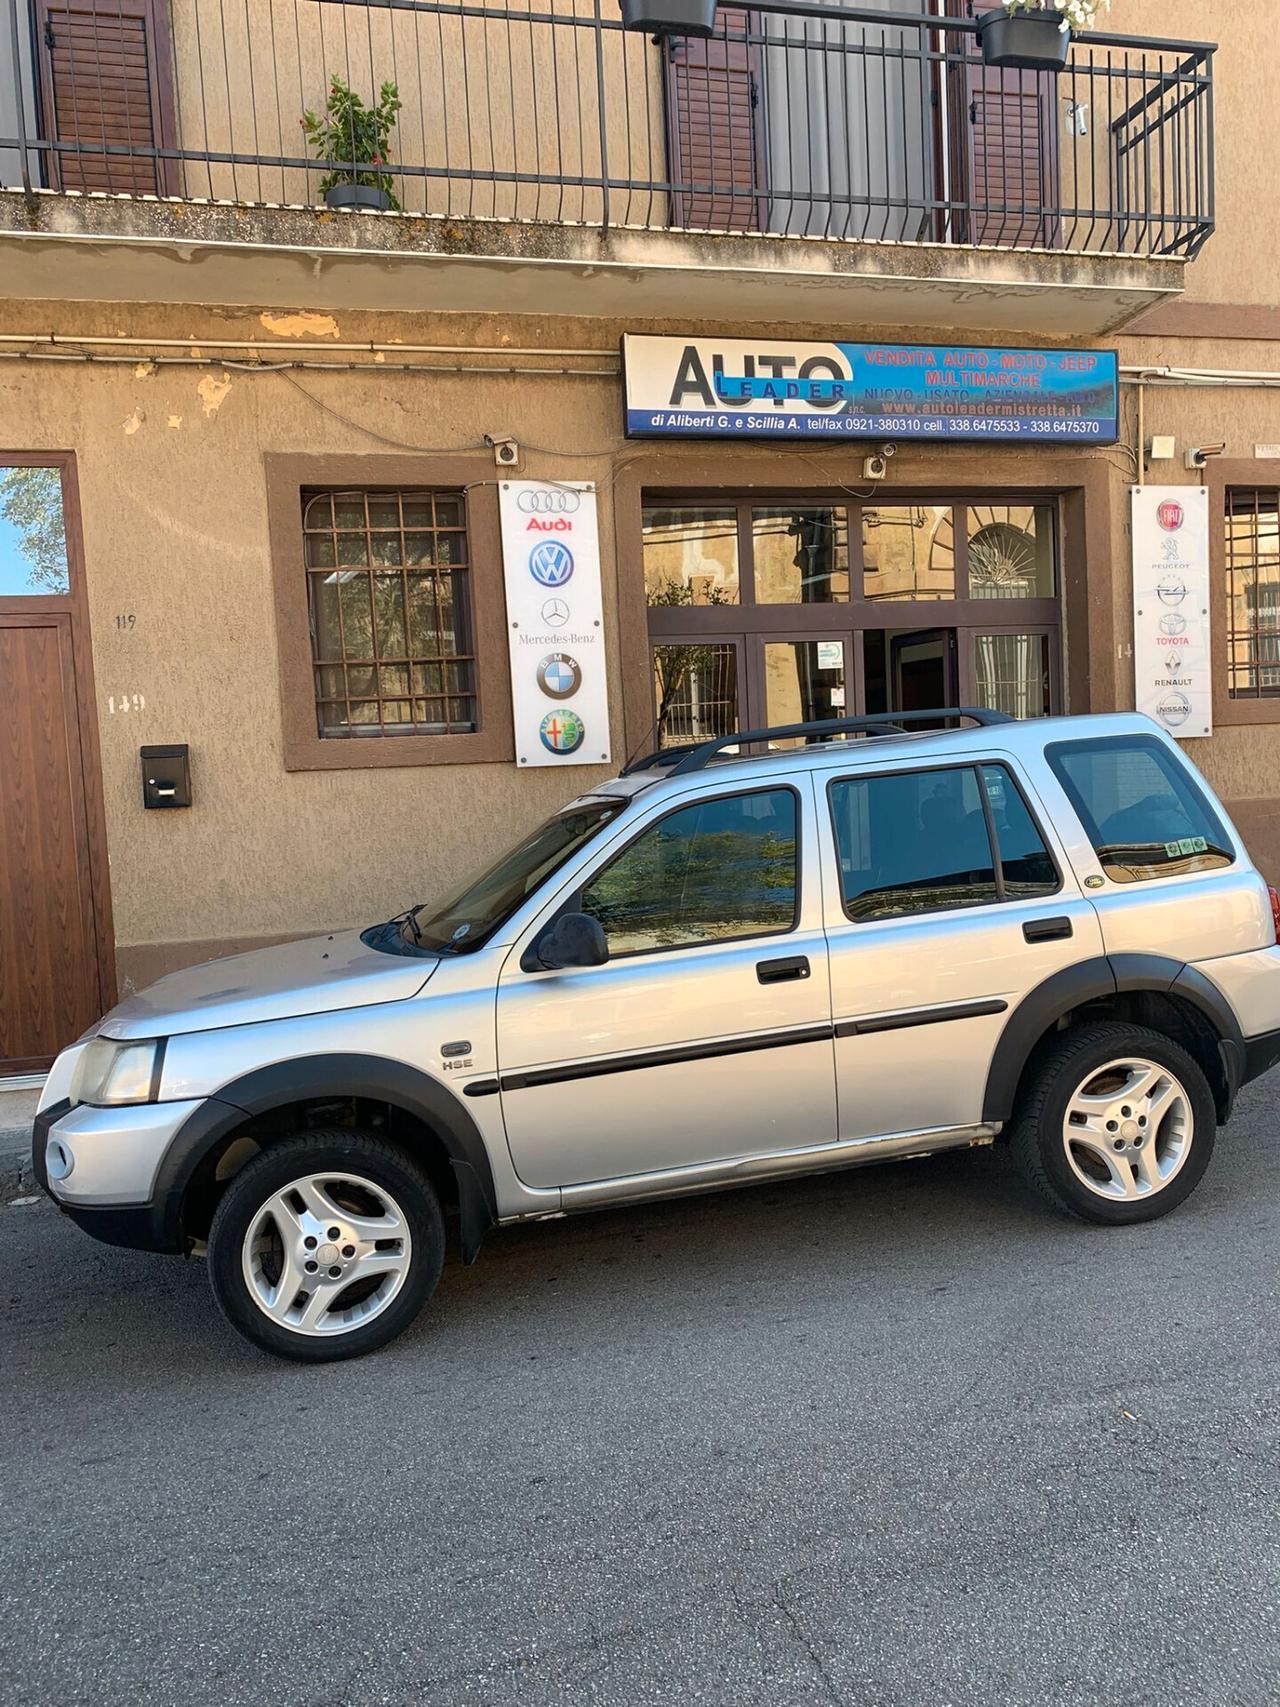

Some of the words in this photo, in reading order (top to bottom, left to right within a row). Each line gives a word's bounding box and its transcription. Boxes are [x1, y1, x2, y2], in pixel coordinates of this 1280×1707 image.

[864, 350, 936, 366] VENDITA
[944, 353, 988, 368] AUTO
[1001, 354, 1046, 369] MOTO
[1059, 356, 1098, 371] JEEP
[669, 346, 847, 408] AUTO
[925, 371, 1041, 388] MULTIMARCHE
[715, 374, 845, 400] LEADER
[864, 388, 913, 401] NUOVO
[925, 389, 970, 402] USATO
[882, 402, 1082, 417] www.autoleadermistretta.it
[651, 413, 664, 425] di
[667, 414, 714, 427] Aliberti
[718, 416, 731, 427] G.
[735, 419, 743, 428] e
[747, 417, 785, 429] Scillia
[787, 418, 801, 429] A.
[807, 417, 843, 430] tel/fax
[845, 419, 921, 432] 0921-380310
[924, 419, 945, 431] cell.
[949, 419, 1021, 432] 338.6475533
[1031, 420, 1099, 433] 338.6475370
[1163, 507, 1179, 523] FIAT
[526, 518, 572, 531] Audi
[115, 614, 137, 630] 119
[519, 633, 595, 646] Mercedes-Benz
[1156, 637, 1190, 646] TOYOTA
[540, 653, 578, 669] BMW
[1154, 679, 1193, 687] RENAULT
[1159, 705, 1189, 713] NISSAN
[442, 1059, 473, 1071] HSE
